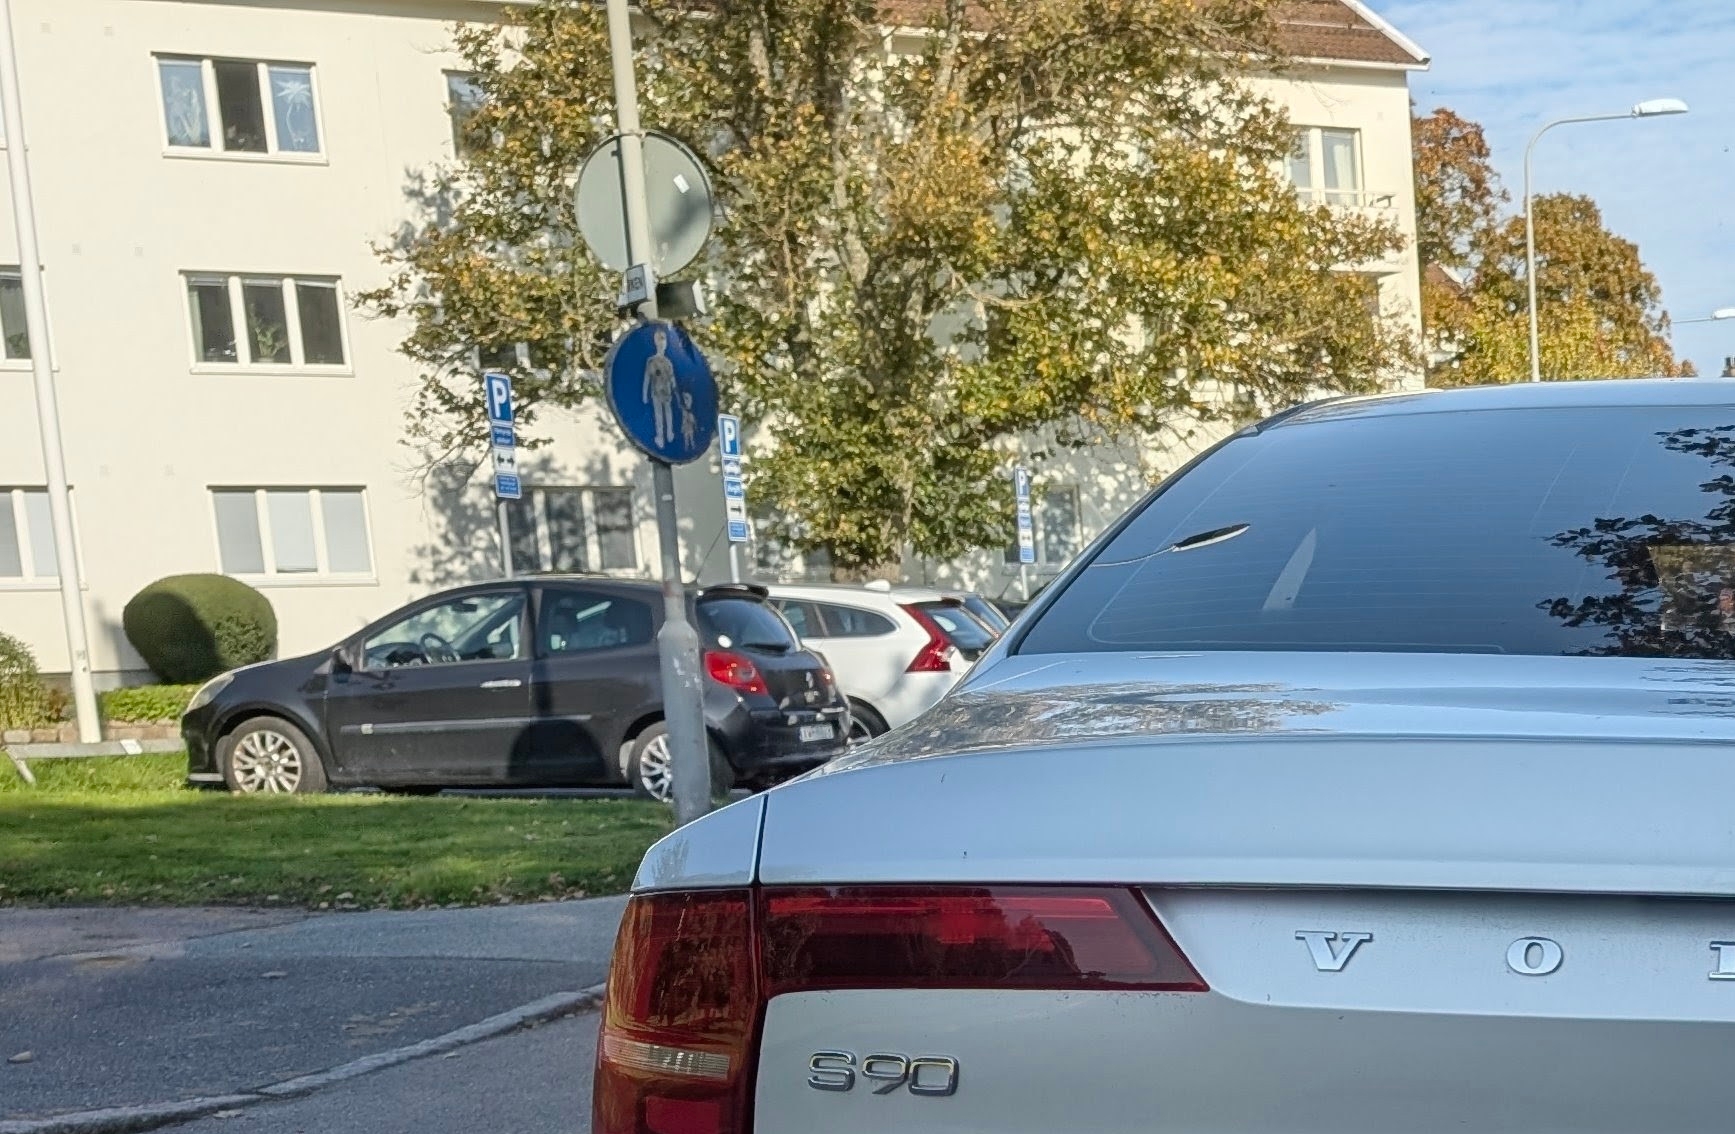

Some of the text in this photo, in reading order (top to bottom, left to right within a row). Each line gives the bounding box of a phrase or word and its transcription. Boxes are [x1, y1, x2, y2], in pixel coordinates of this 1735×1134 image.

[491, 379, 507, 418] P
[723, 420, 736, 453] P
[807, 1049, 960, 1097] S90
